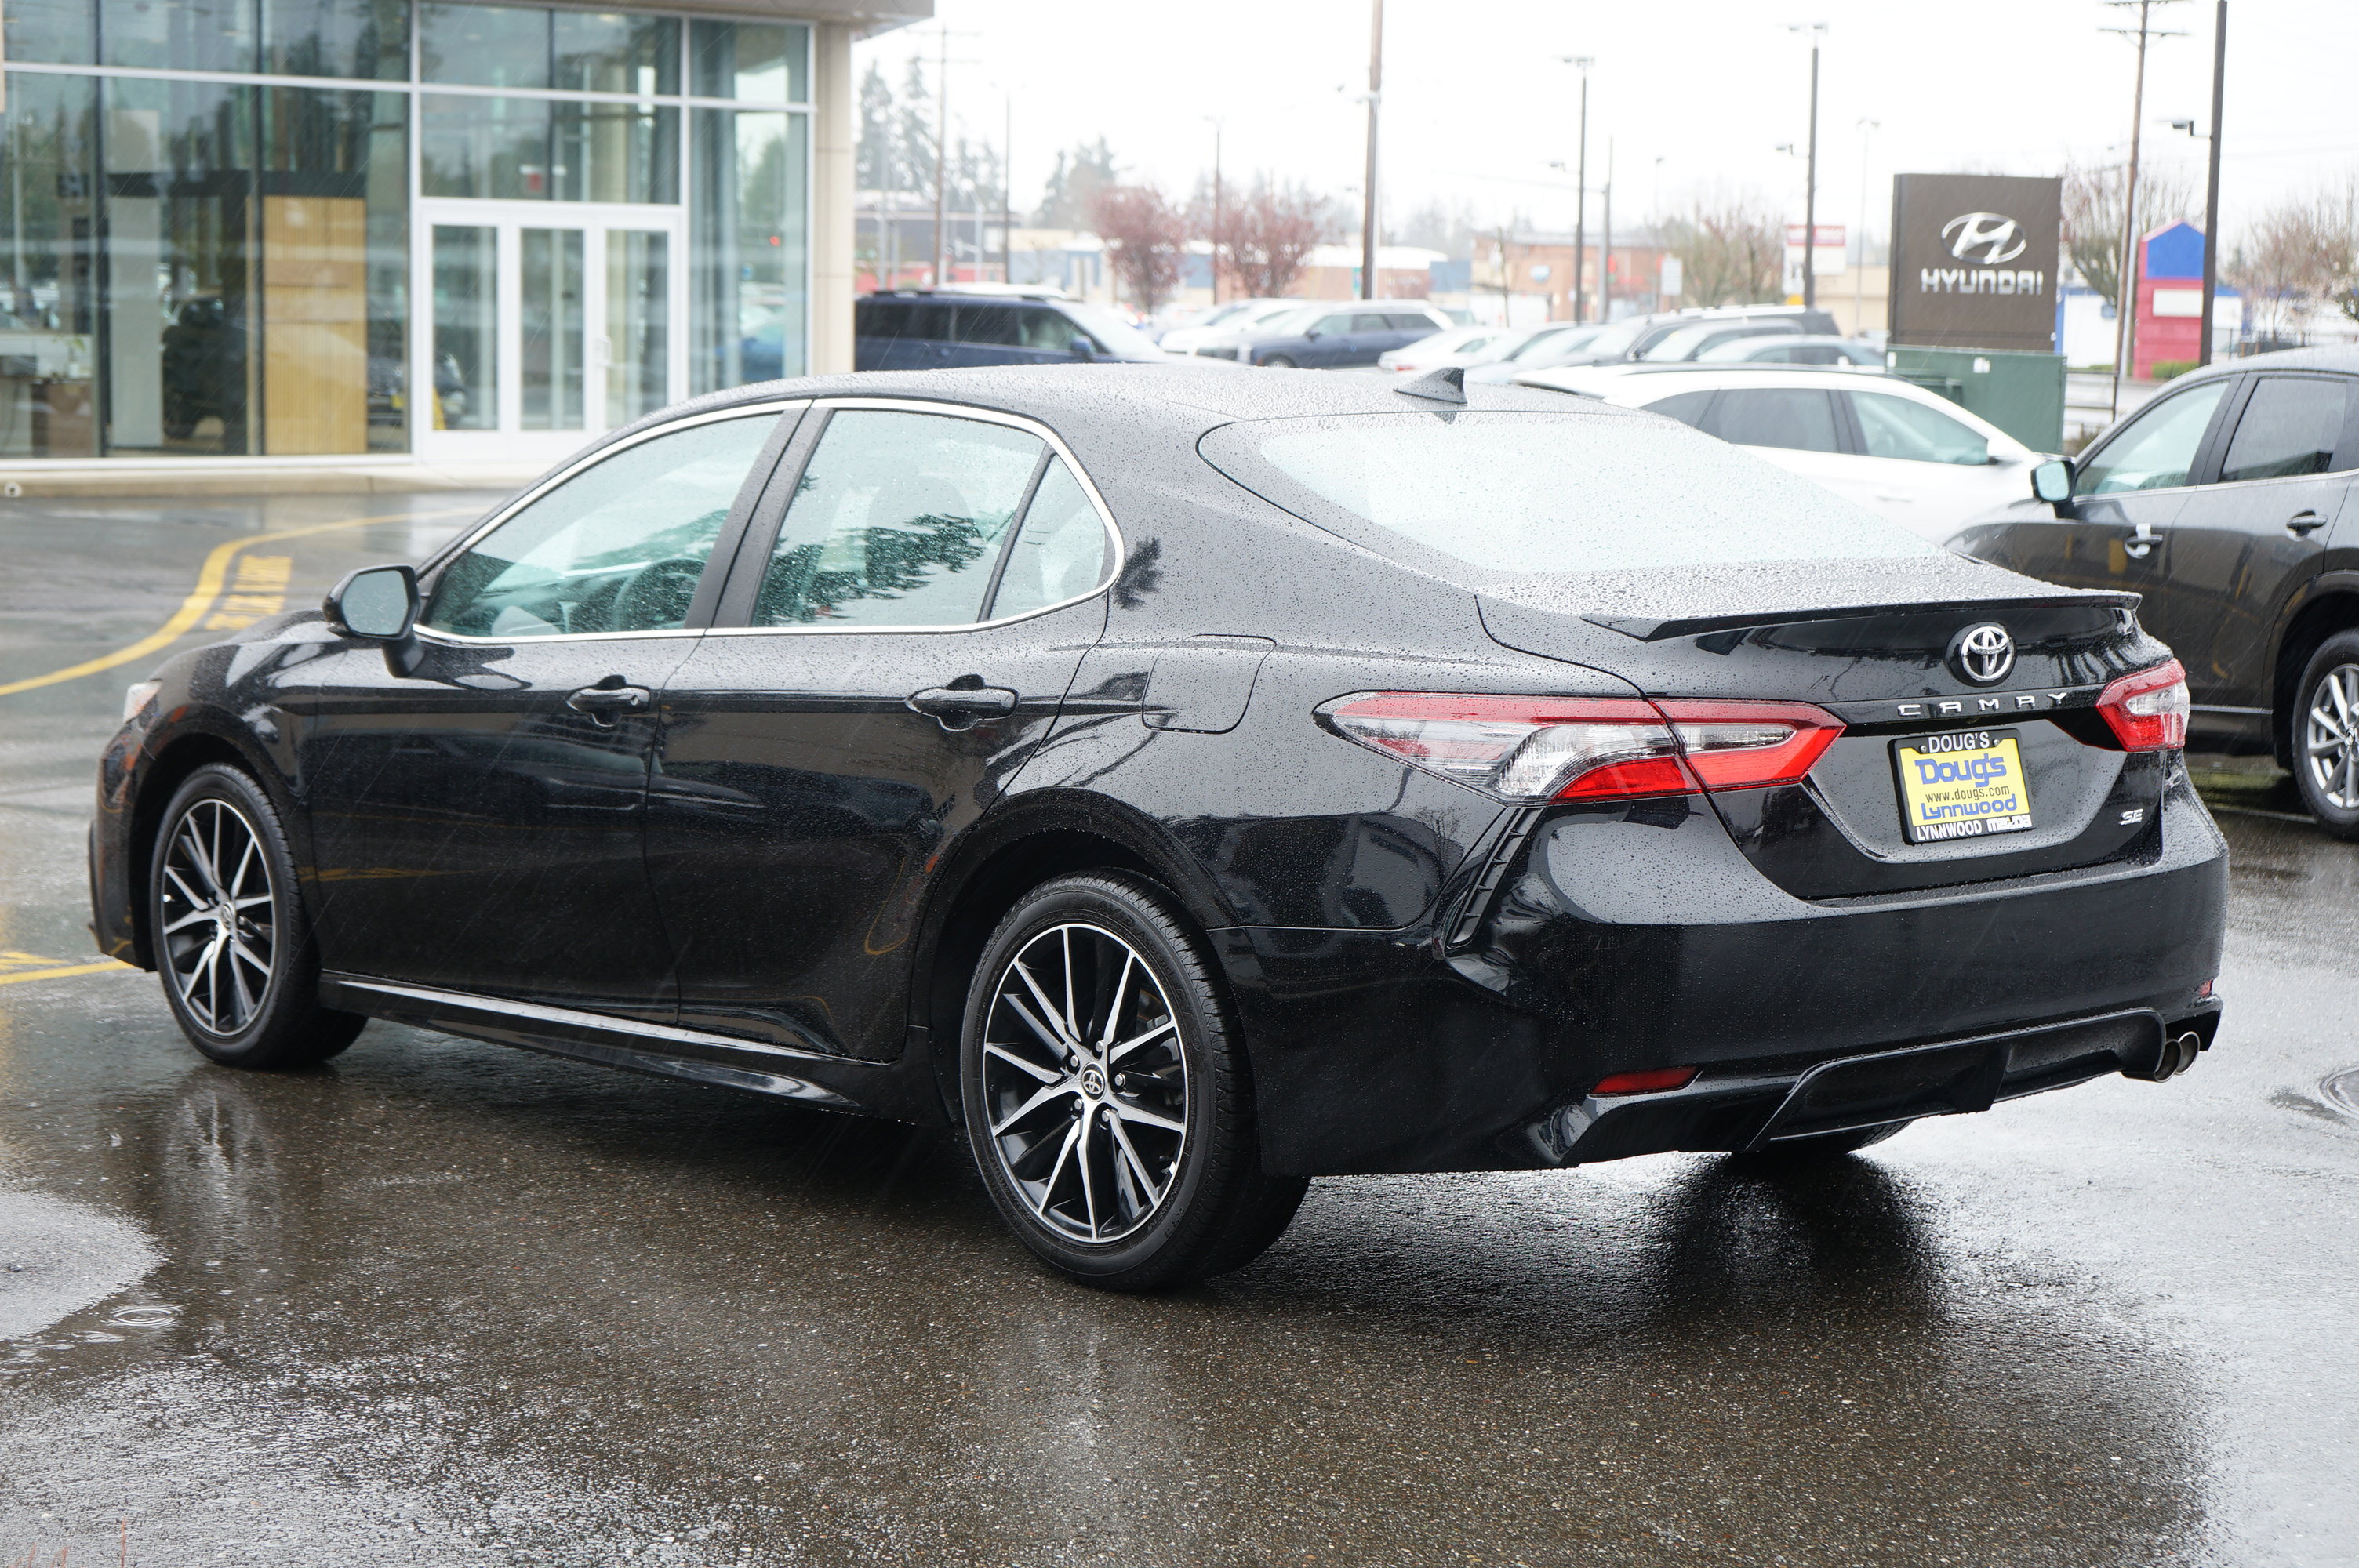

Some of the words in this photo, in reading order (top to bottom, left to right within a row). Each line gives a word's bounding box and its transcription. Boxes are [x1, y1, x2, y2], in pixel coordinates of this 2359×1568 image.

[1921, 267, 2044, 295] HYUNDAI
[1897, 692, 2068, 717] CAMRY
[1928, 731, 1990, 753] DOUG'S
[1925, 785, 2010, 803] www.dougs.com
[1920, 793, 2018, 821] Lynnwood
[2119, 808, 2144, 826] SE
[1916, 820, 1983, 841] LYNNWOOD
